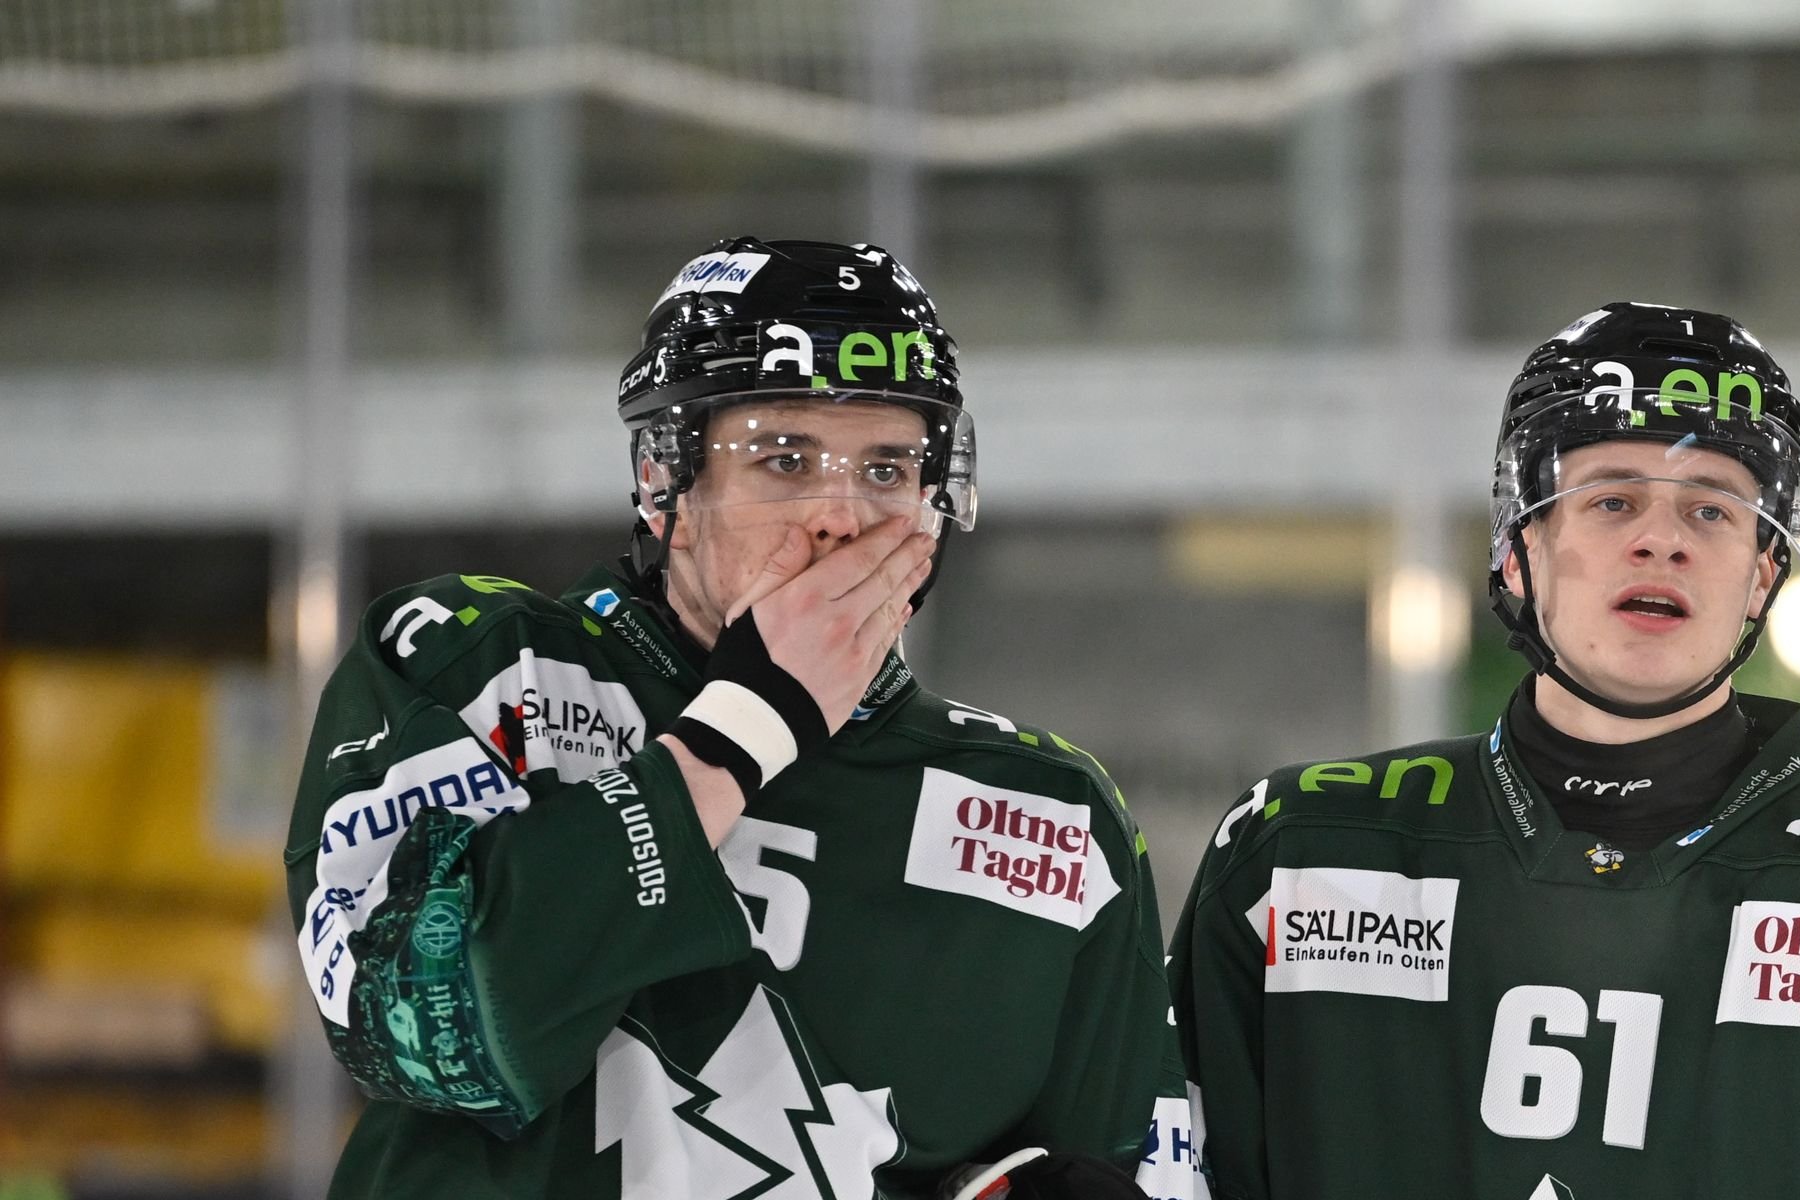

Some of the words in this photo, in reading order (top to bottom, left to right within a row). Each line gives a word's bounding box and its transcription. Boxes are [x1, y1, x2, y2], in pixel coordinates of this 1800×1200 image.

[838, 266, 861, 290] 5
[619, 361, 652, 396] CCM
[653, 347, 668, 384] 5
[1584, 361, 1763, 427] a.en
[620, 610, 678, 677] Aargauische
[590, 743, 605, 757] in
[1491, 754, 1537, 838] Kantonalbank
[620, 803, 665, 907] Saison
[716, 816, 818, 971] 5
[1285, 909, 1446, 952] SÄLIPARK
[1285, 946, 1370, 965] Einkaufen
[1376, 950, 1394, 965] in
[1401, 953, 1444, 971] Olten
[1480, 984, 1664, 1150] 61
